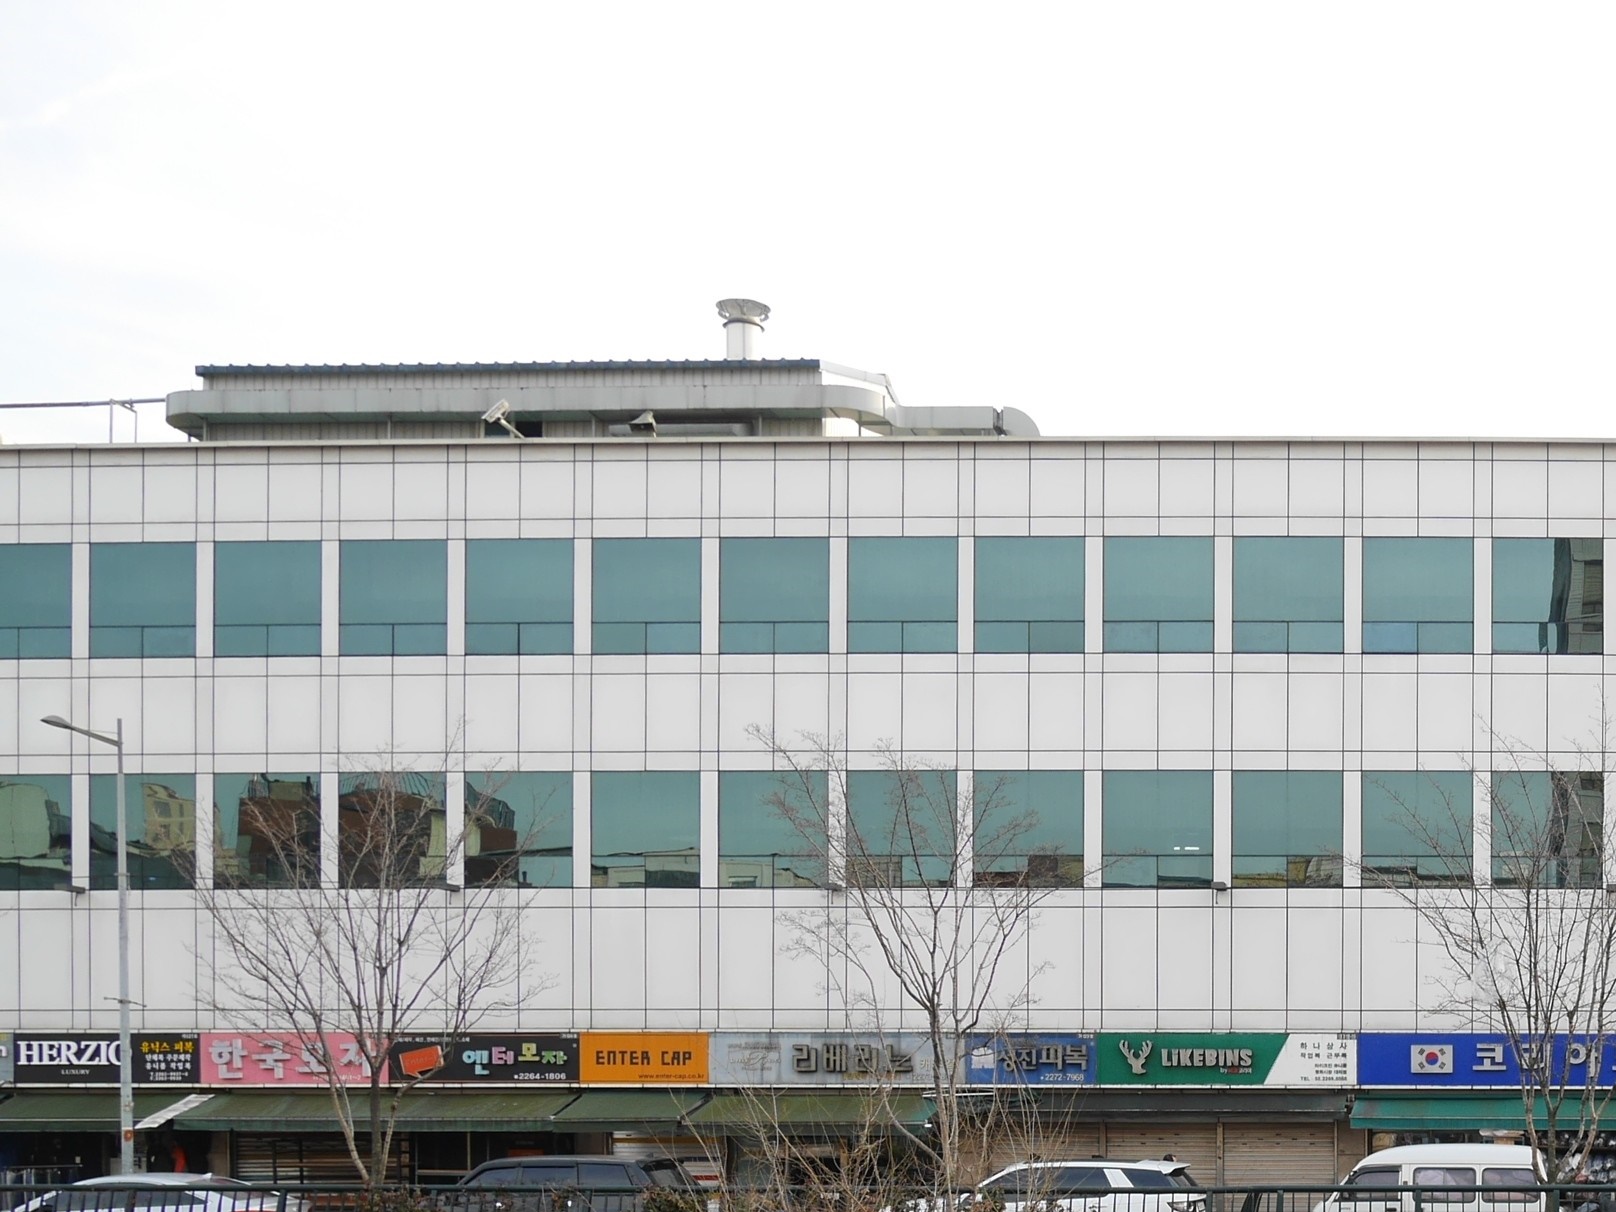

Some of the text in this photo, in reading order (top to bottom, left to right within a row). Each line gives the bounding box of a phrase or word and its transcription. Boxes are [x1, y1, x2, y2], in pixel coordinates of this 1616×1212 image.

[140, 1041, 194, 1053] 유닉스 피복
[209, 1038, 378, 1080] 한국모자
[661, 1050, 692, 1066] CAP
[518, 1073, 567, 1081] 2264-1806
[1045, 1073, 1084, 1081] 2272-7968
